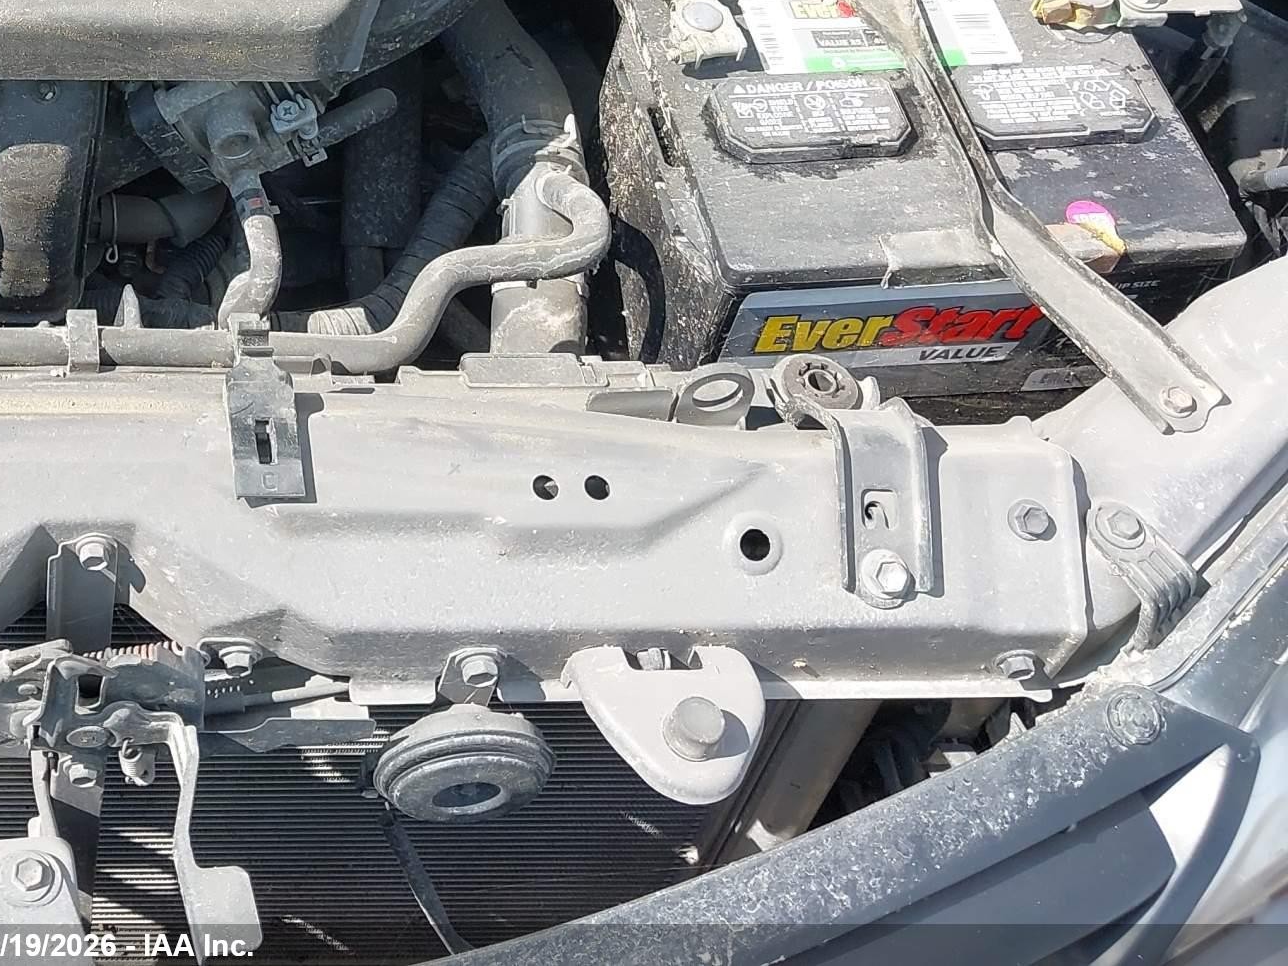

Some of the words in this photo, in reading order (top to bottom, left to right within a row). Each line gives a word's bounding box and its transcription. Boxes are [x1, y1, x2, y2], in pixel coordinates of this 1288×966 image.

[746, 82, 803, 94] DANGER
[816, 76, 868, 91] POISON
[754, 303, 1045, 353] EverStart
[919, 345, 999, 361] VALUE
